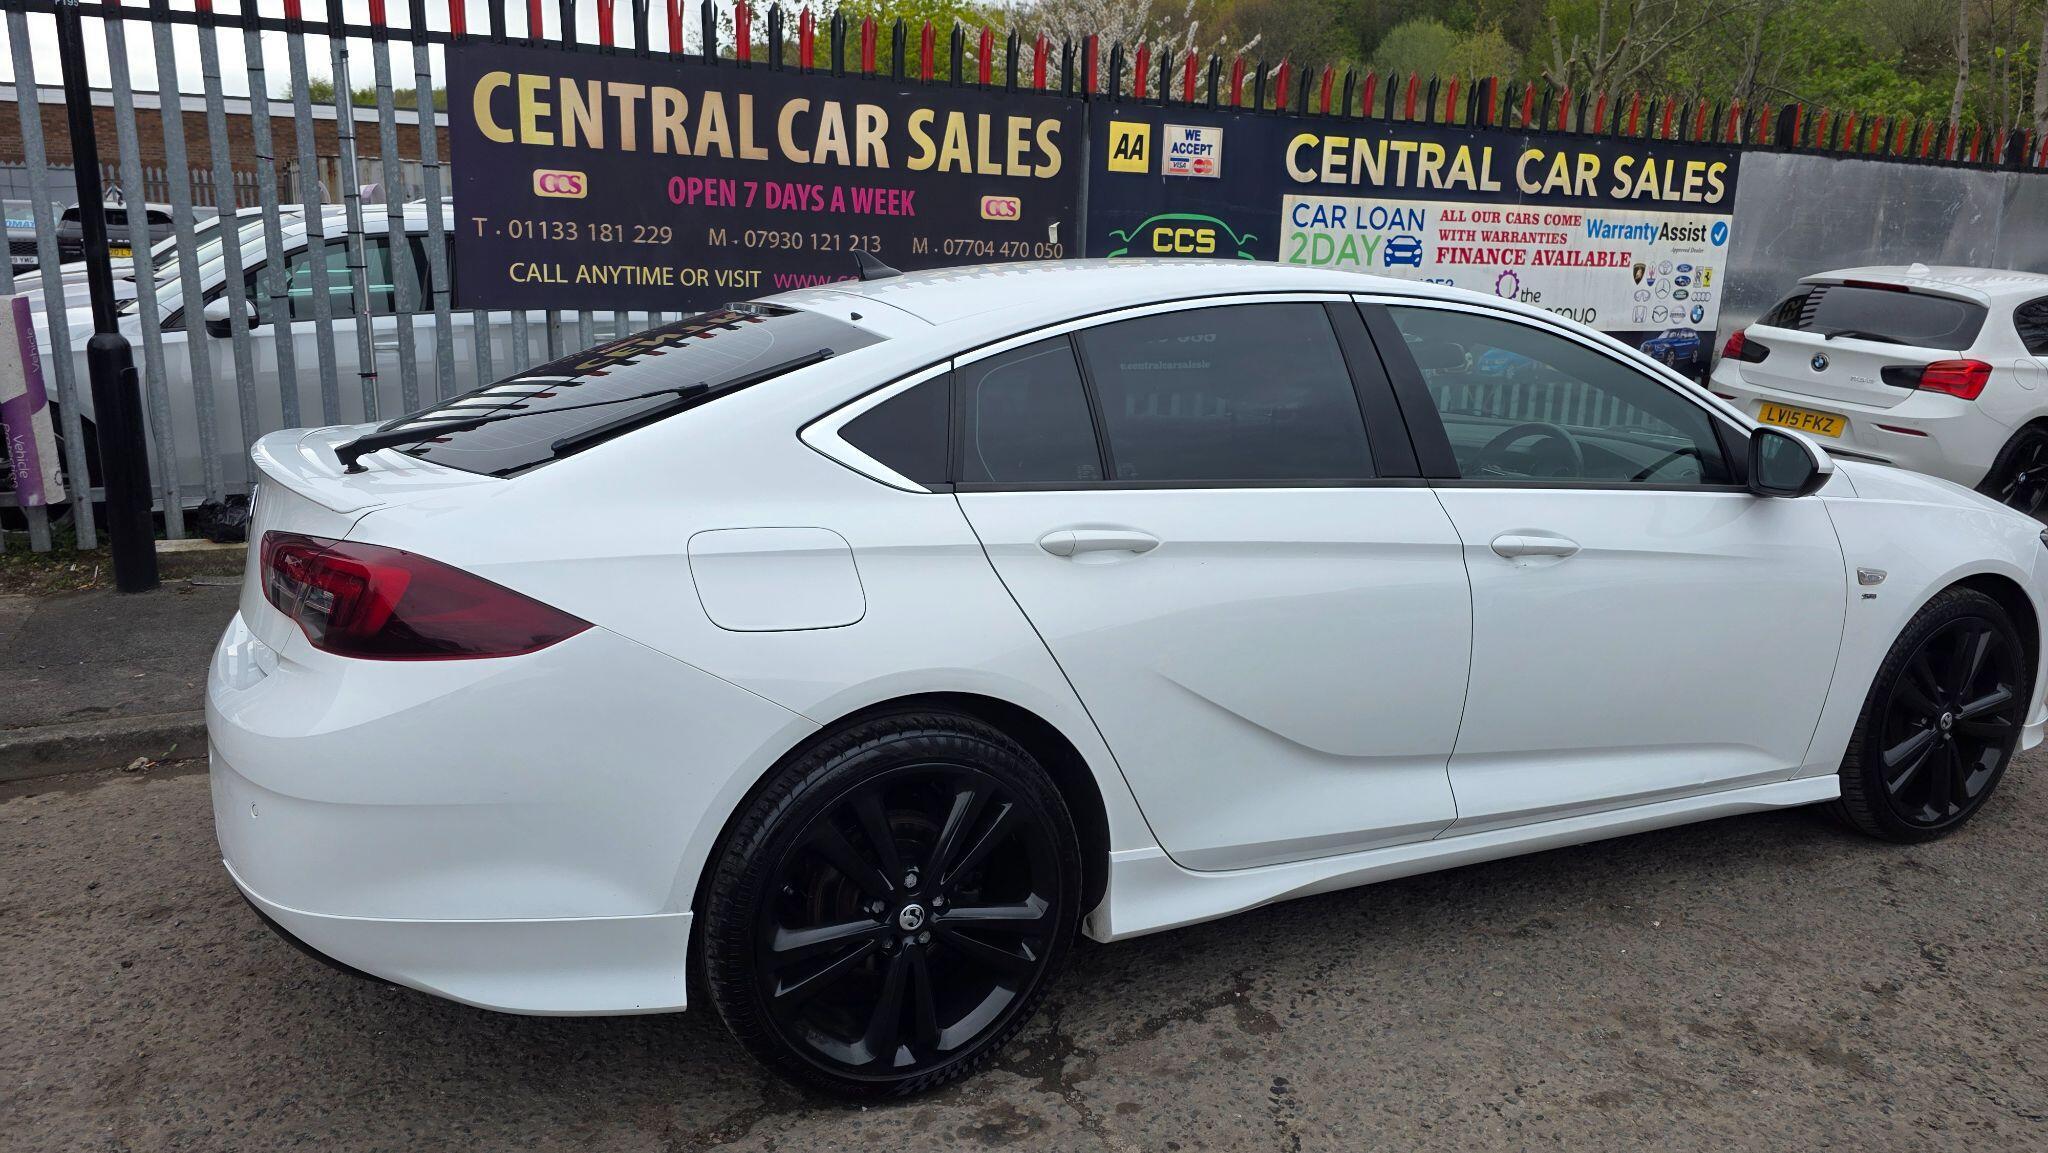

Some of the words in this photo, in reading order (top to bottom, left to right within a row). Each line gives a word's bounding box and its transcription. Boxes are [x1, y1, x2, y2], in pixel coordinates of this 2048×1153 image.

[473, 71, 768, 161] CENTRAL
[777, 97, 890, 169] CAR
[907, 108, 1062, 179] SALES
[1185, 129, 1202, 141] WE
[1113, 133, 1144, 160] AA
[1171, 142, 1213, 155] ACCEPT
[1285, 133, 1501, 192] CENTRAL
[1515, 148, 1601, 197] CAR
[1610, 155, 1728, 204] SALES
[668, 176, 736, 207] OPEN
[743, 181, 758, 207] 7
[765, 181, 824, 212] DAYS
[830, 186, 846, 213] A
[850, 187, 916, 216] WEEK
[1292, 203, 1347, 229] CAR
[1356, 206, 1426, 232] LOAN
[1440, 209, 1467, 222] ALL
[1471, 211, 1501, 224] OUR
[1506, 212, 1540, 226] CARS
[1544, 214, 1582, 227] COME
[508, 219, 578, 241] 01133
[588, 223, 623, 243] 181
[633, 225, 673, 244] 229
[744, 230, 803, 250] 07930
[811, 233, 840, 251] 121
[849, 235, 881, 252] 213
[1153, 228, 1216, 254] CCS
[1438, 229, 1476, 242] WITH
[1481, 231, 1568, 245] WARRANTIES
[943, 239, 995, 257] 07704
[1000, 241, 1030, 258] 470
[1034, 242, 1064, 259] 050
[1288, 231, 1382, 267] 2DAY
[1435, 247, 1526, 266] FINANCE
[1531, 249, 1632, 268] AVAILABLE
[509, 262, 569, 284] CALL
[575, 264, 674, 287] ANYTIME
[680, 268, 709, 287] OR
[715, 269, 762, 288] VISIT
[1520, 287, 1541, 303] the
[27, 327, 40, 373] Vehicle
[1766, 407, 1801, 426] LV15
[1802, 413, 1835, 433] FKZ
[13, 434, 28, 479] Vehicle
